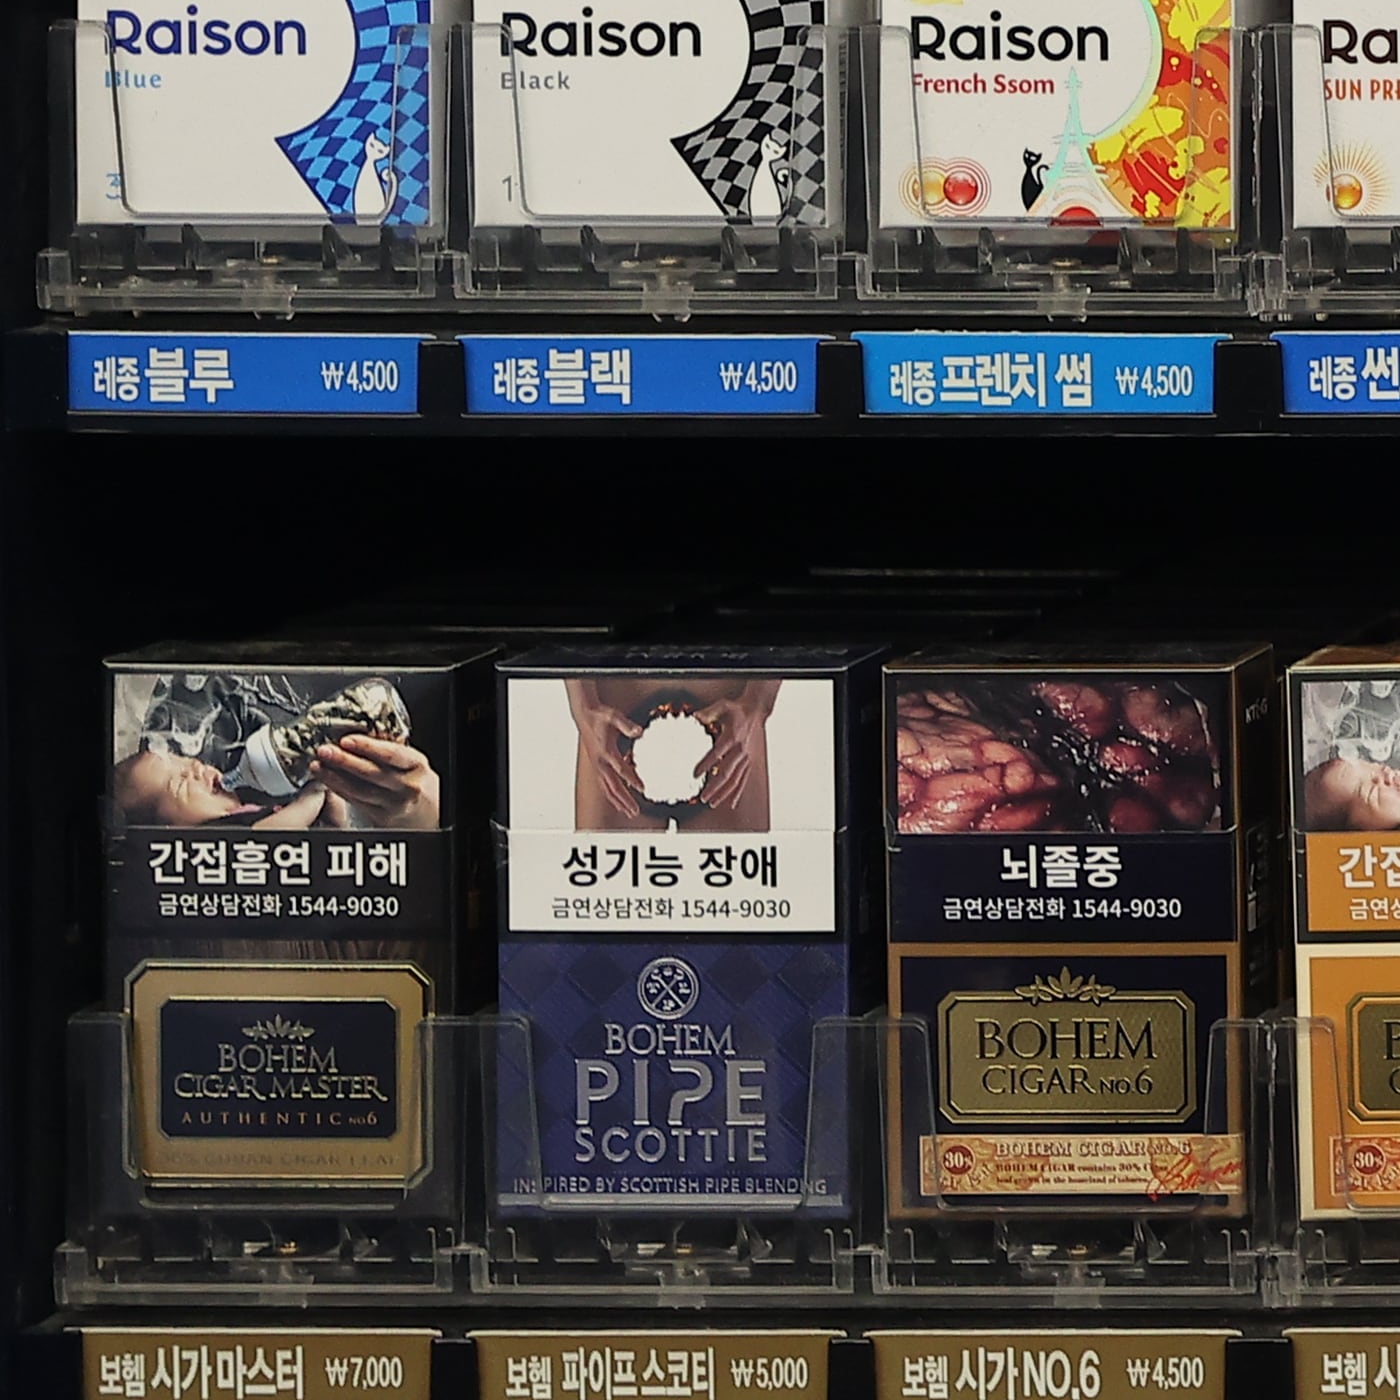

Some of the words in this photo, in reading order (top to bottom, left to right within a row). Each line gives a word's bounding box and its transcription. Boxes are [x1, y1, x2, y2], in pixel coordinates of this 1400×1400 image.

[103, 5, 306, 60] Raison
[497, 7, 701, 62] Raison
[106, 66, 161, 93] Blue
[501, 67, 569, 94] Black
[911, 68, 986, 99] French
[994, 74, 1054, 94] Ssom
[1322, 75, 1361, 104] SUN
[94, 357, 140, 401] 레종
[145, 348, 233, 402] 블루
[321, 361, 397, 393] ₩4,500
[891, 361, 937, 405] 레종
[940, 353, 1045, 407] 프렌치
[1055, 353, 1093, 406] 썸
[1116, 366, 1194, 398] ₩4,500
[1310, 356, 1356, 400] 레종
[150, 841, 310, 884] 간접흡연
[327, 842, 406, 886] 피해
[563, 845, 683, 887] 성기능
[699, 846, 777, 887] 장애
[1001, 845, 1122, 888] 뇌졸중
[943, 897, 1065, 919] 금연상담전화
[1073, 899, 1181, 918] 1544-9030
[605, 1024, 735, 1055] BOHEM
[975, 1017, 1157, 1059] BOHEM
[218, 1044, 338, 1073] BOHEM
[175, 1073, 266, 1100] CIGAR
[269, 1076, 388, 1101] MASTER
[575, 1059, 766, 1127] PIPE
[983, 1065, 1096, 1094] CIGAR
[182, 1112, 341, 1124] AUTHENTIC
[576, 1127, 766, 1162] SCOTTIE
[591, 1174, 620, 1193] BY
[616, 1174, 704, 1193] SCOTTISH
[701, 1174, 744, 1193] PIPE
[99, 1354, 145, 1397] 보헴
[151, 1345, 212, 1400] 시가
[217, 1346, 303, 1400] 마스터
[325, 1357, 402, 1389] ₩7,000
